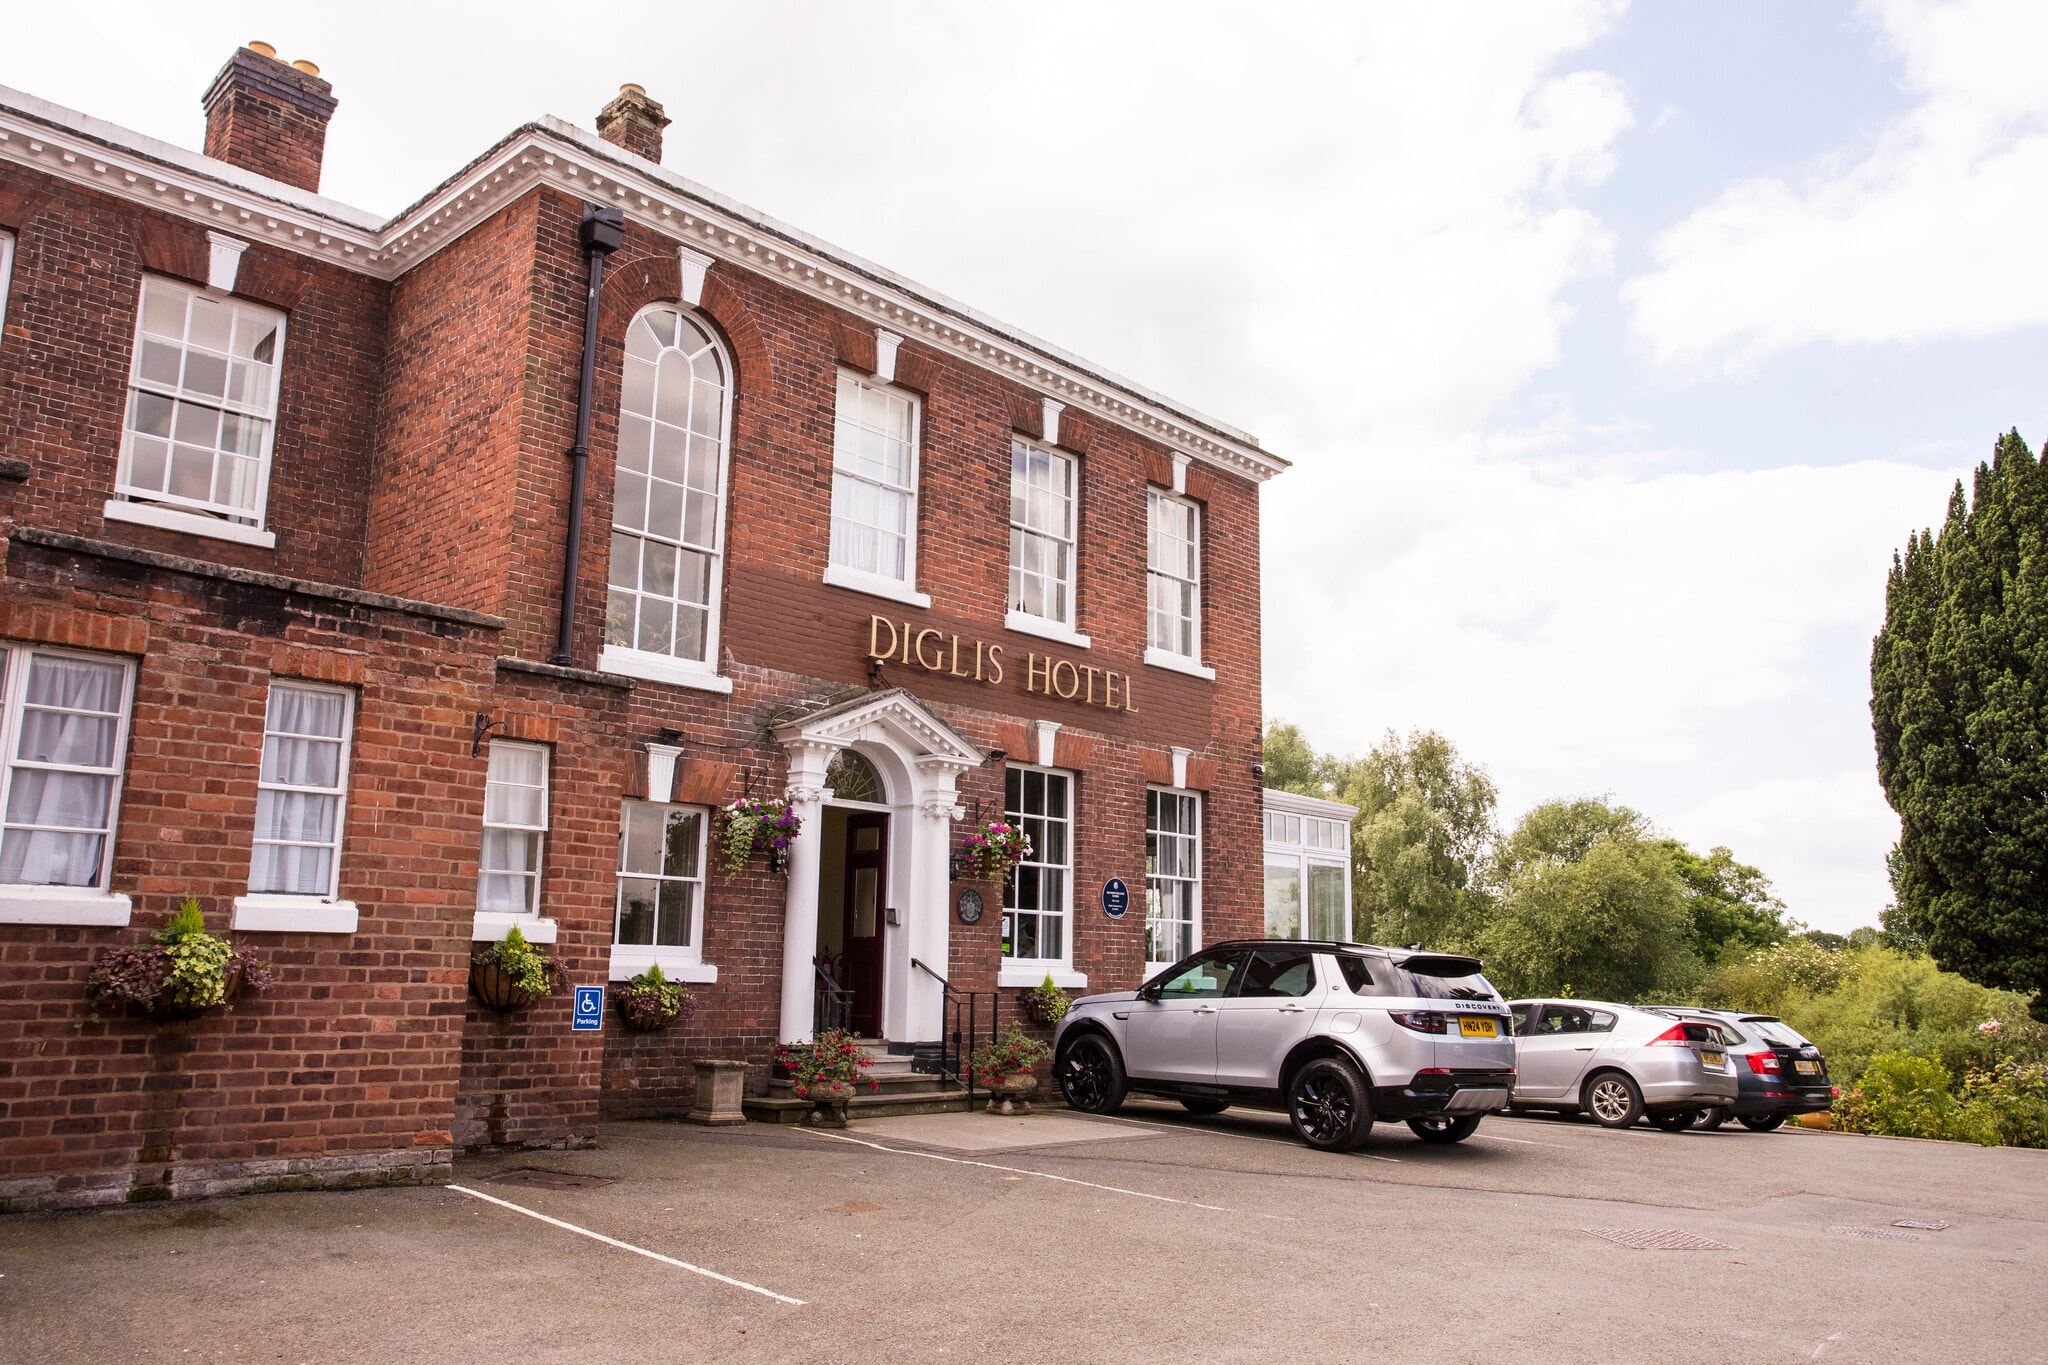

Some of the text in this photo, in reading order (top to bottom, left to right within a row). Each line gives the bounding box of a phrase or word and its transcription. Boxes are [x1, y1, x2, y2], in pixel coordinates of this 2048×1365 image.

[868, 614, 1139, 713] DIGLIS HOTEL
[1462, 1021, 1480, 1032] HN24
